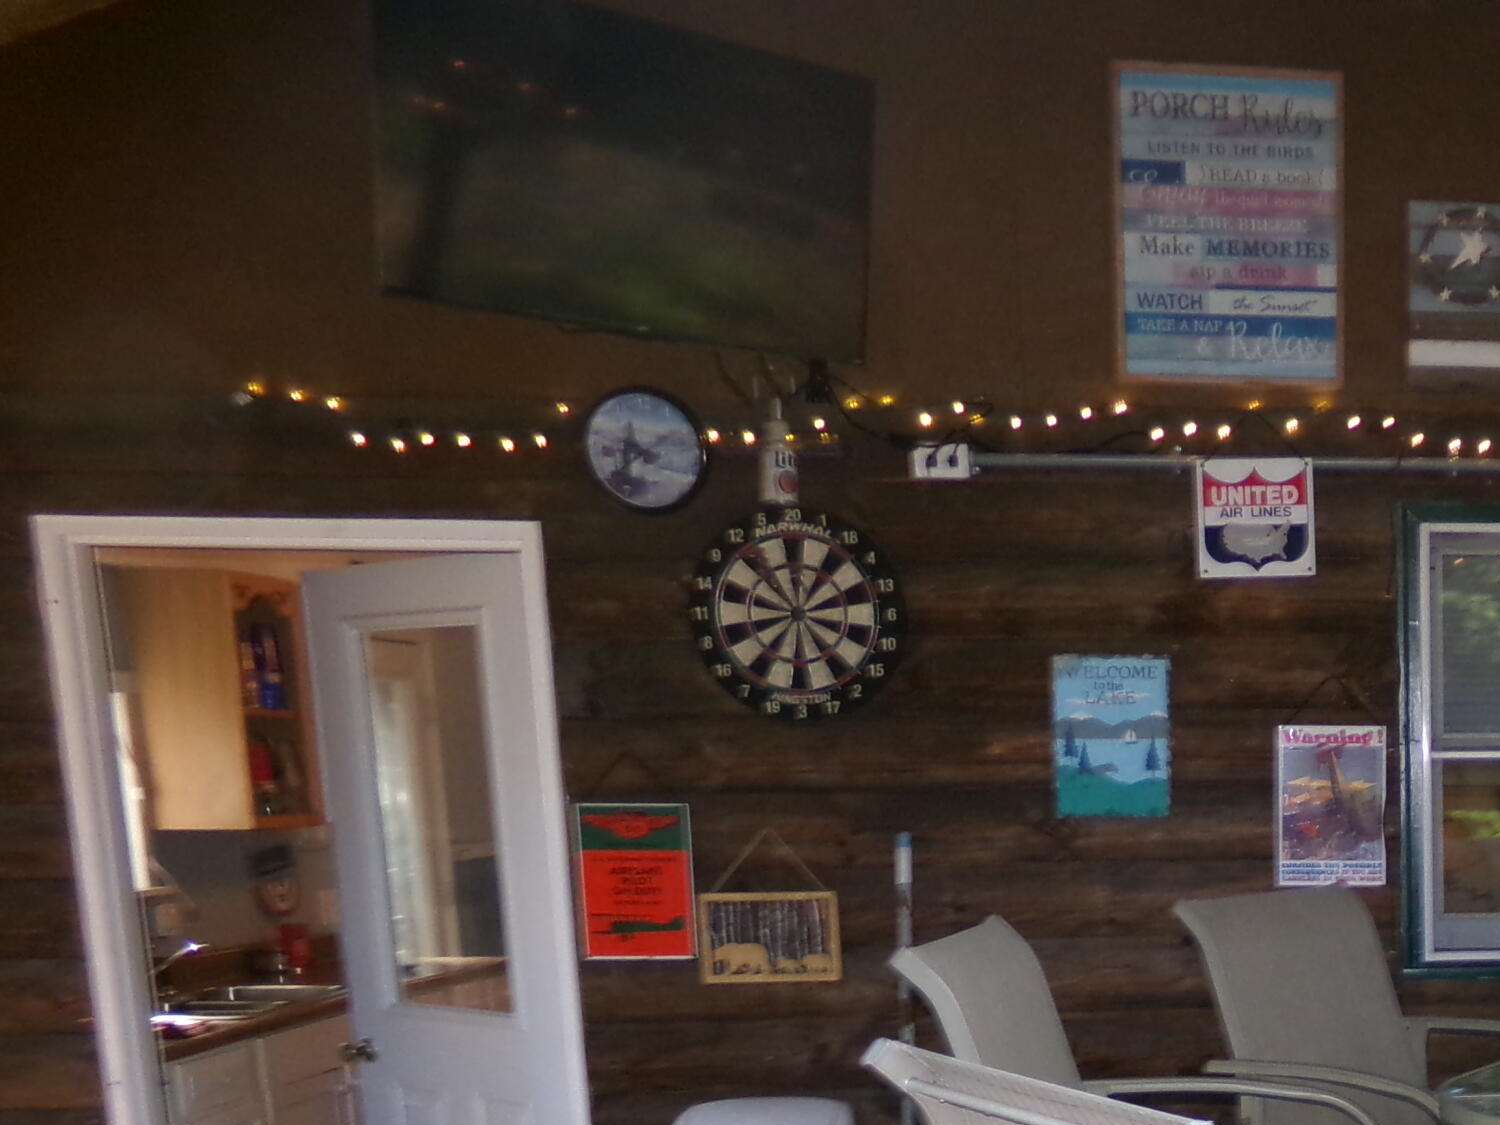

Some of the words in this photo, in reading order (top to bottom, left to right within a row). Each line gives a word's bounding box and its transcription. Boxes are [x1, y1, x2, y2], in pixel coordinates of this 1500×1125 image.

[1130, 90, 1229, 120] PORCH
[1241, 94, 1323, 140] Rules
[1147, 141, 1200, 154] LISTEN
[1207, 142, 1225, 155] TO
[1231, 143, 1258, 157] THE
[1266, 145, 1314, 159] BIRDS
[1209, 167, 1257, 183] READ
[1277, 168, 1313, 184] book
[1145, 213, 1194, 229] FEEL
[1199, 215, 1234, 231] THE
[1239, 217, 1308, 233] BREEZE
[1140, 235, 1195, 256] Make
[1206, 239, 1330, 258] MEMORIES
[1222, 268, 1233, 279] a
[1237, 265, 1288, 281] drink
[1136, 292, 1203, 311] WATCH
[1232, 296, 1253, 310] the
[1260, 295, 1319, 313] Sunset
[1137, 318, 1176, 331] TAKE
[1179, 319, 1190, 331] A
[1194, 320, 1223, 332] NAP
[1210, 485, 1299, 506] UNITED
[784, 509, 801, 522] 20
[1220, 507, 1243, 518] AIR
[1251, 506, 1292, 518] LINES
[757, 513, 767, 526] 5
[820, 513, 827, 526] 1
[728, 529, 744, 543] 12
[755, 522, 833, 538] NARWHAL
[842, 530, 858, 544] 18
[711, 550, 721, 562] 9
[866, 551, 875, 565] 4
[698, 577, 712, 590] 14
[879, 579, 894, 592] 13
[694, 606, 708, 620] 11
[887, 608, 896, 620] 6
[704, 635, 713, 648] 8
[880, 637, 896, 650] 10
[716, 664, 732, 677] 16
[869, 664, 885, 676] 15
[1060, 664, 1158, 680] WELCOME
[740, 685, 751, 698] 7
[853, 685, 863, 697] 2
[1094, 681, 1105, 690] to
[1107, 681, 1124, 690] the
[1085, 690, 1136, 705] LAKE
[765, 701, 780, 713] 19
[798, 705, 808, 719] 3
[826, 701, 841, 714] 17
